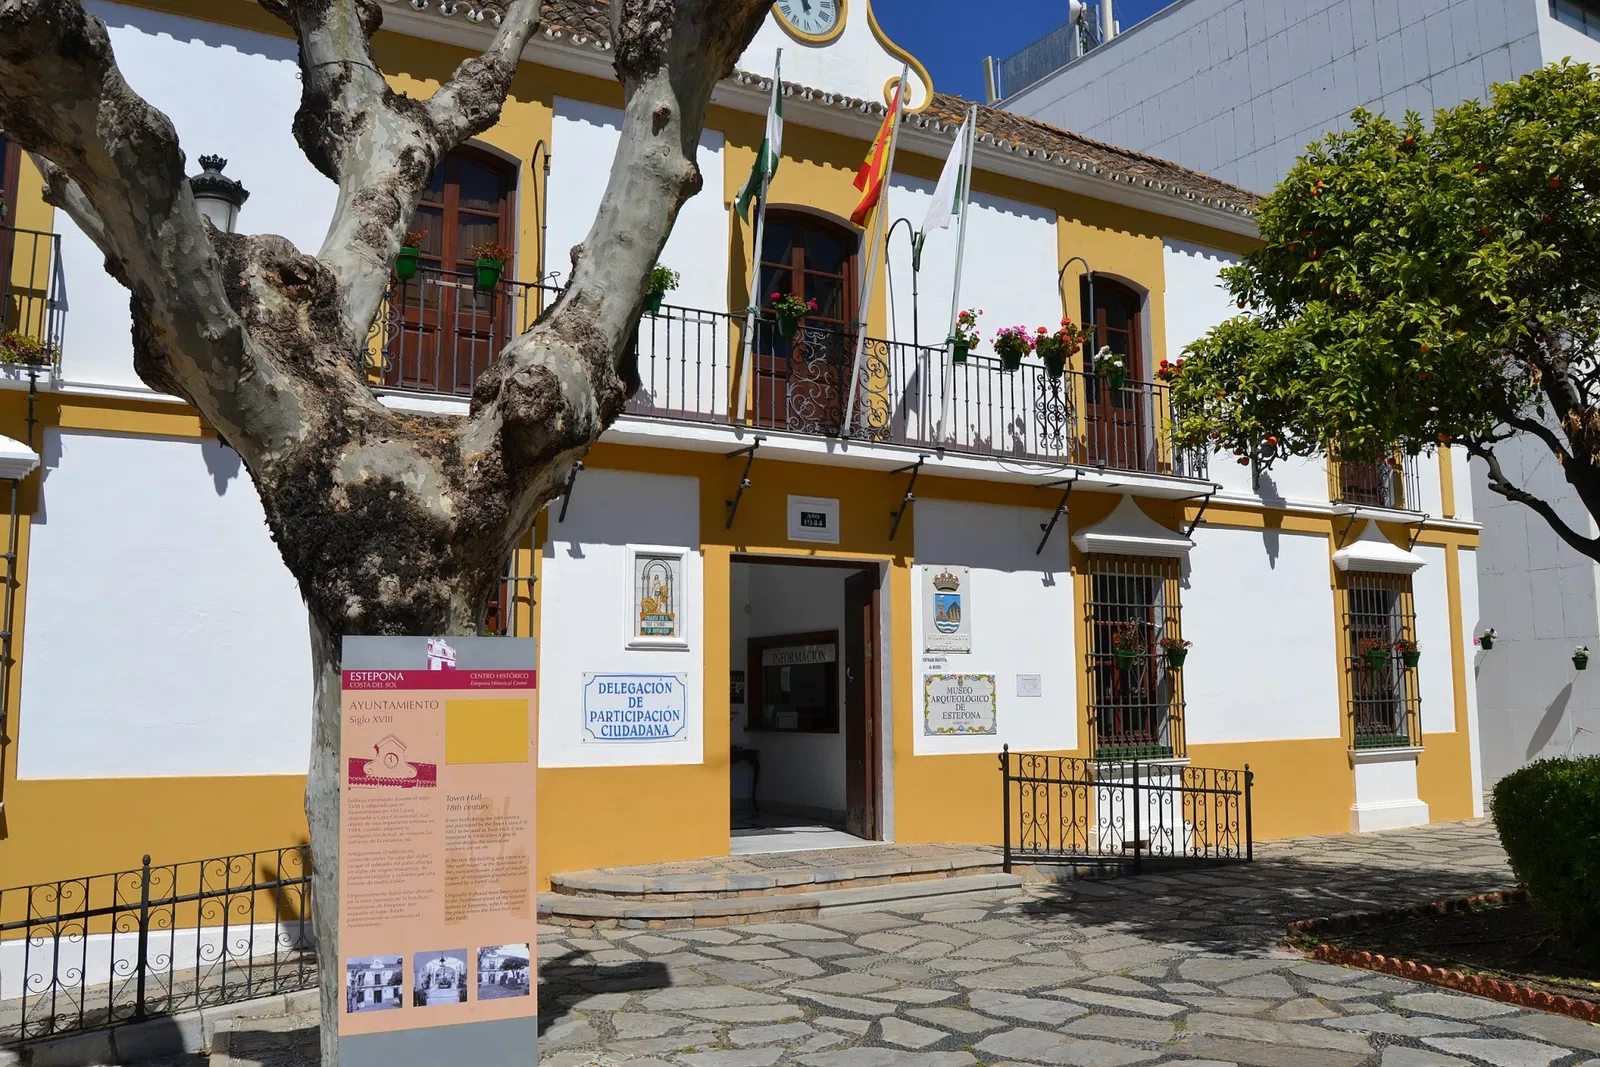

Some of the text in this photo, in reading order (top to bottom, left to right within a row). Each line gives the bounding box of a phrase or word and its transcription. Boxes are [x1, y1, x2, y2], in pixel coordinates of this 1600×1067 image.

[772, 648, 826, 664] INFORMACIÓN
[350, 672, 404, 681] ESTEPONA
[598, 678, 672, 695] DELEGACIÓN
[628, 697, 644, 708] DE
[931, 695, 990, 704] ARQUEOLÓGICO
[349, 700, 439, 710] AYUNTAMIENTO
[590, 706, 680, 723] PARTICIPACIÓN
[942, 712, 981, 720] ESTEPONA
[349, 715, 393, 725] Siglo XVIII
[601, 725, 670, 737] CIUDADANA
[467, 793, 482, 801] Hall
[464, 804, 490, 812] century
